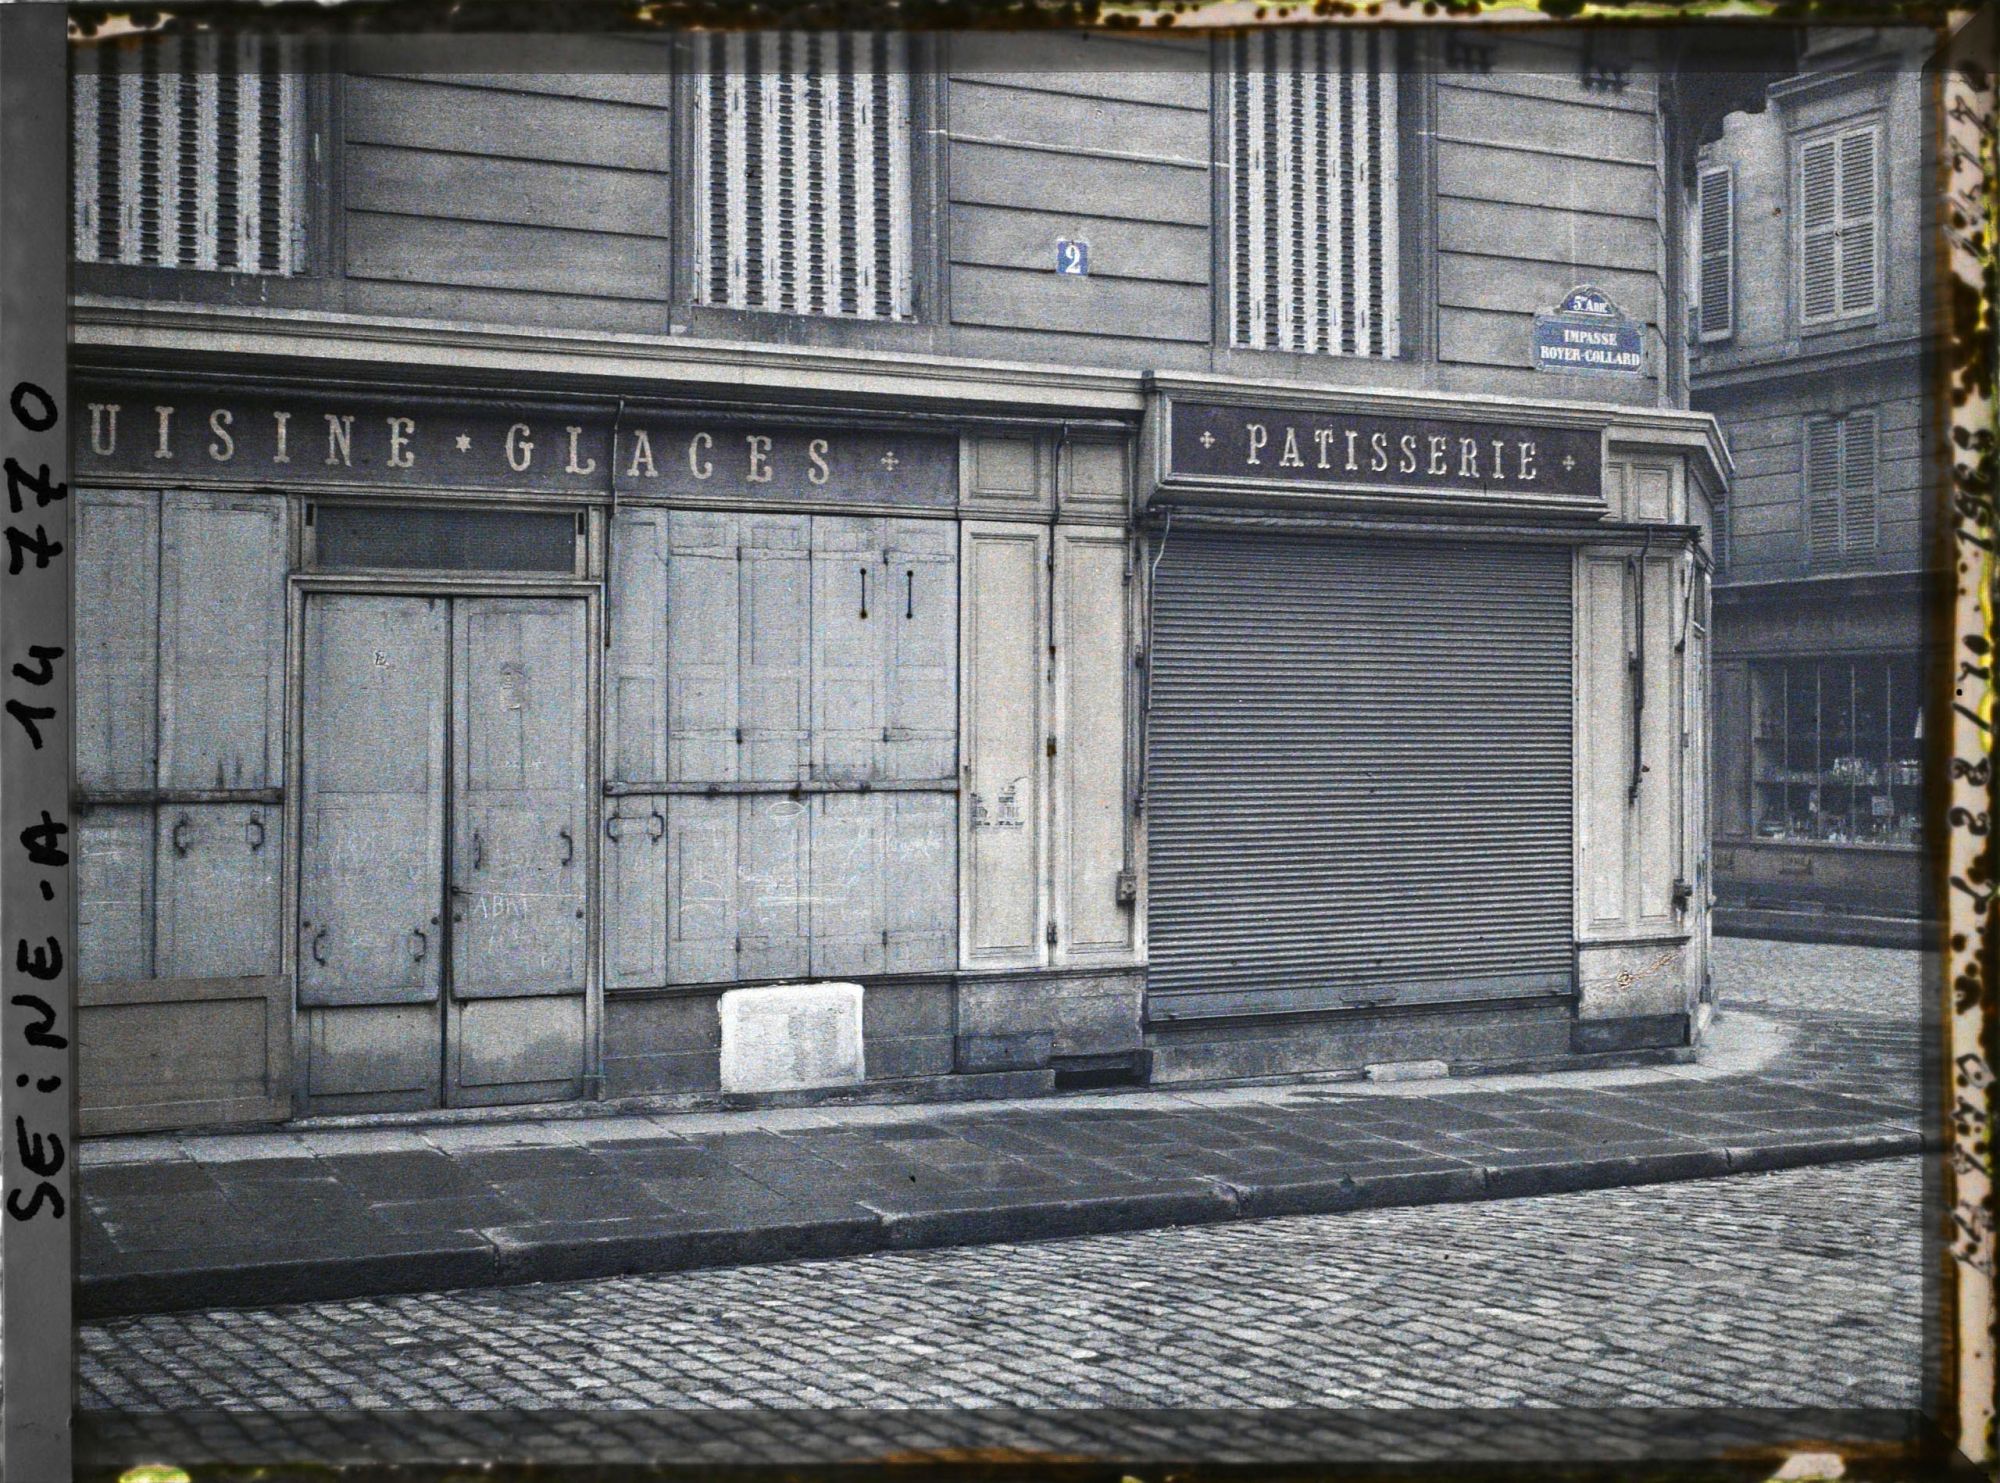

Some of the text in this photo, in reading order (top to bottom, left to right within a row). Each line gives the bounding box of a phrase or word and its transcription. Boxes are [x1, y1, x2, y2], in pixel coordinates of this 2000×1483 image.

[1065, 244, 1081, 274] 2
[1563, 329, 1618, 346] IMPASSE
[1540, 345, 1641, 366] ROYER-COLLARD
[88, 402, 832, 485] UISINE GLACES
[1246, 423, 1538, 480] PATISSERIE
